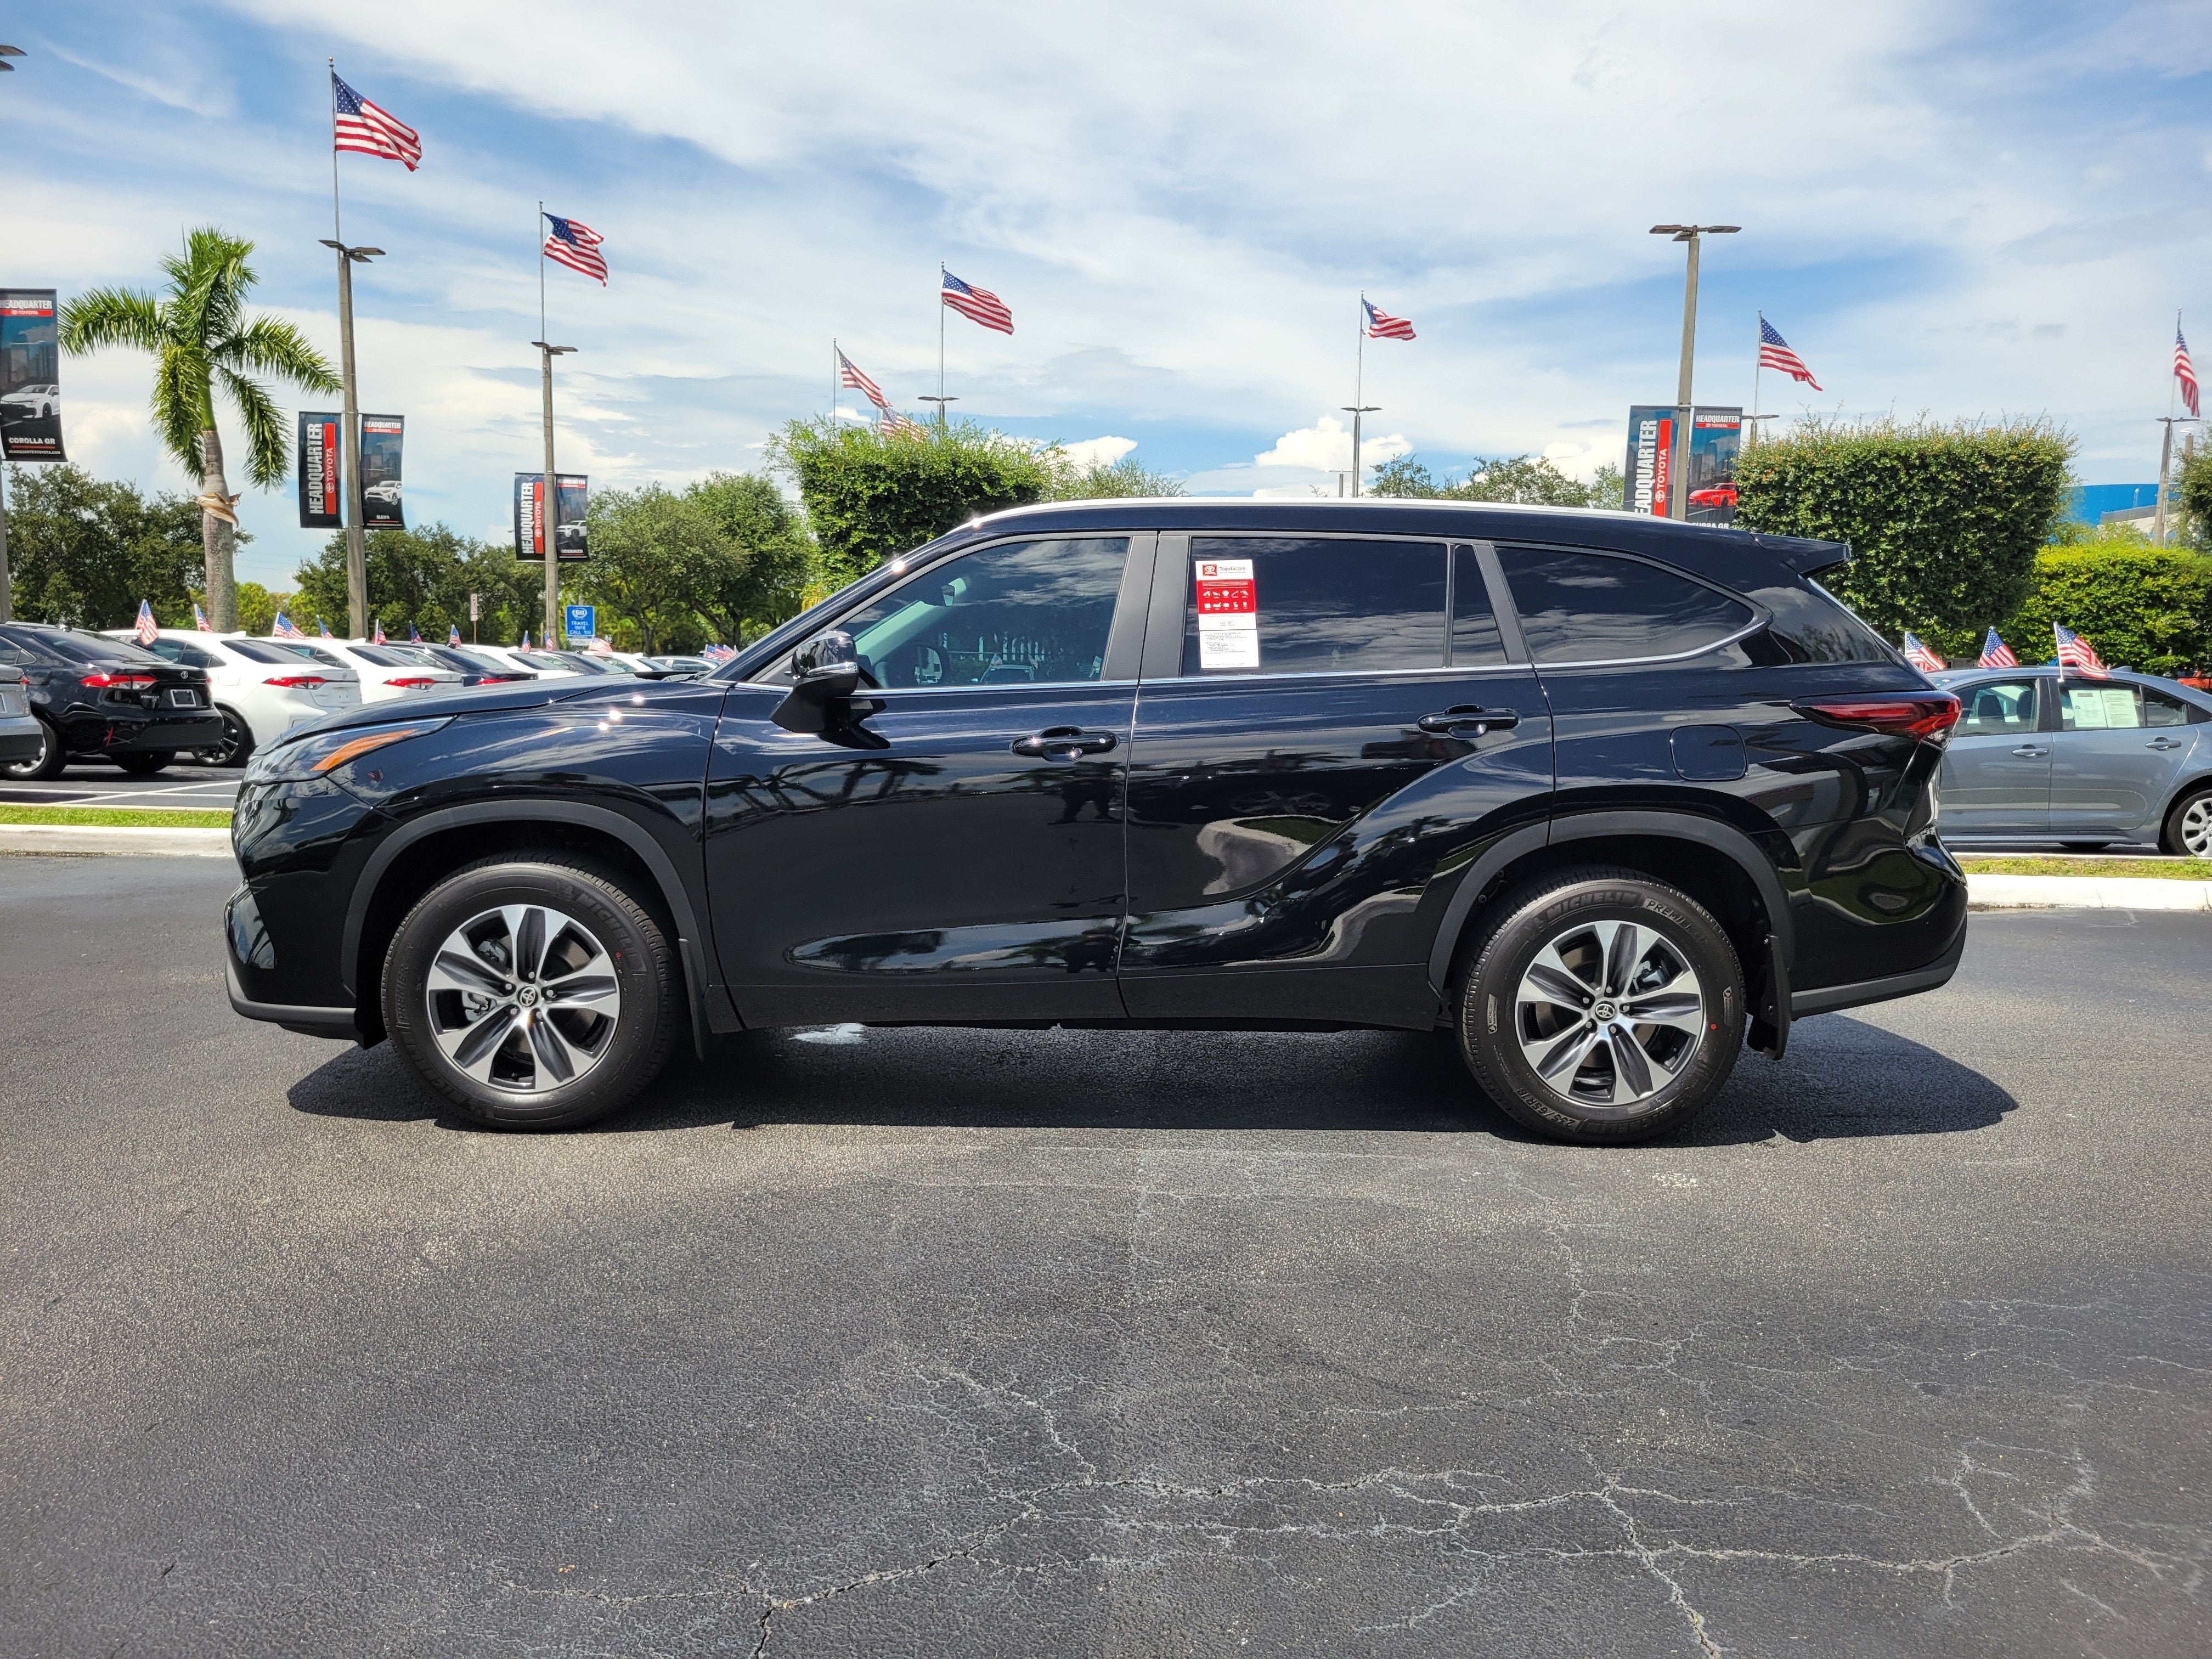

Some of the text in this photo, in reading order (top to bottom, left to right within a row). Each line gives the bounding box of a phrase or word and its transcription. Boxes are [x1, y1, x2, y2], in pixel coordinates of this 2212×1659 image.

[1696, 415, 1740, 423] HEADQUARTER
[307, 423, 324, 514] HEADQUARTER
[1634, 420, 1657, 515] EADQUARTER
[1657, 449, 1667, 489] TOYOTA
[520, 482, 534, 554] HEADQUARTER
[576, 893, 647, 971] MICHELIN
[1547, 891, 1639, 921] MICHELIN
